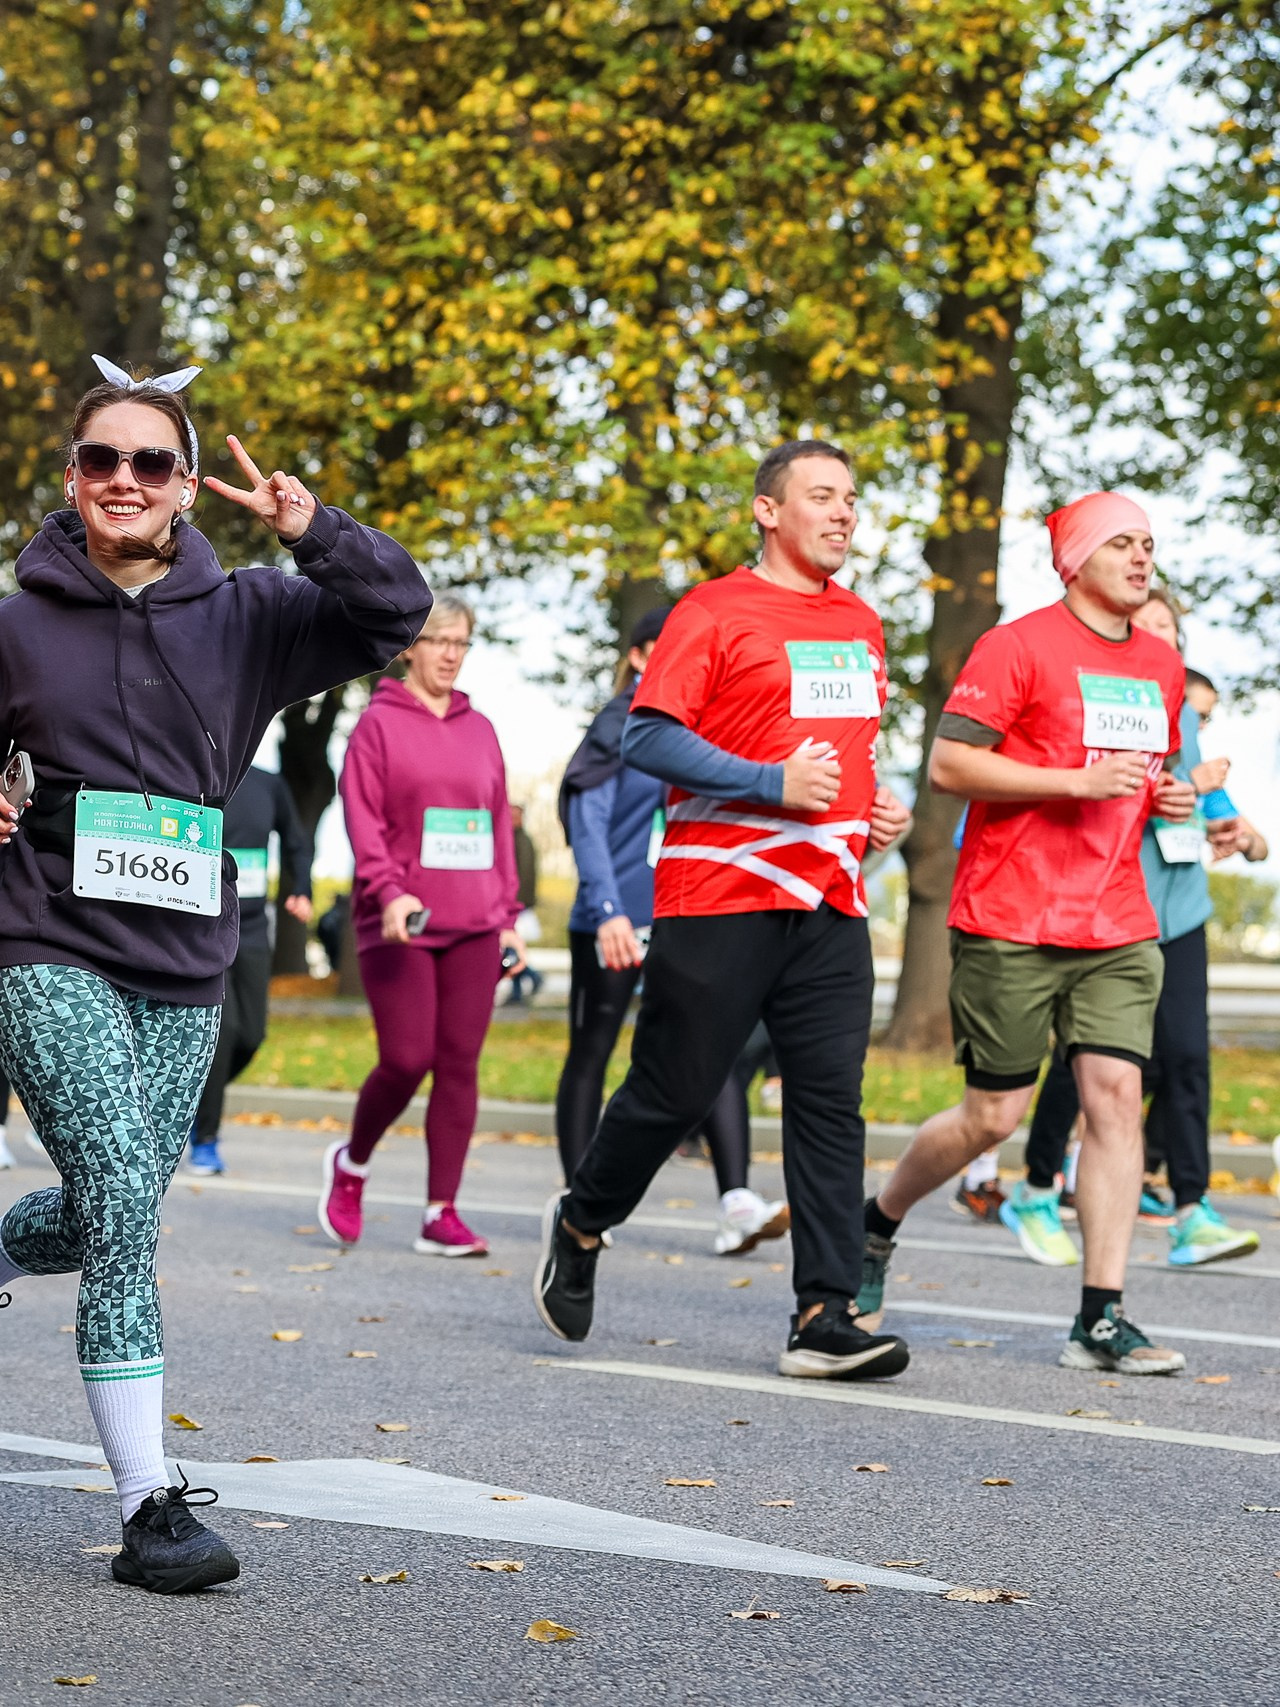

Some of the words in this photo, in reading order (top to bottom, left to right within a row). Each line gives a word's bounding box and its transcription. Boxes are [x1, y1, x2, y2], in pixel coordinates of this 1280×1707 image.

[809, 681, 852, 700] 51121
[1097, 711, 1149, 734] 51296
[93, 818, 112, 827] МОЯ
[113, 819, 154, 832] СТОЛИЦА
[163, 818, 177, 833] D
[94, 849, 190, 886] 51686
